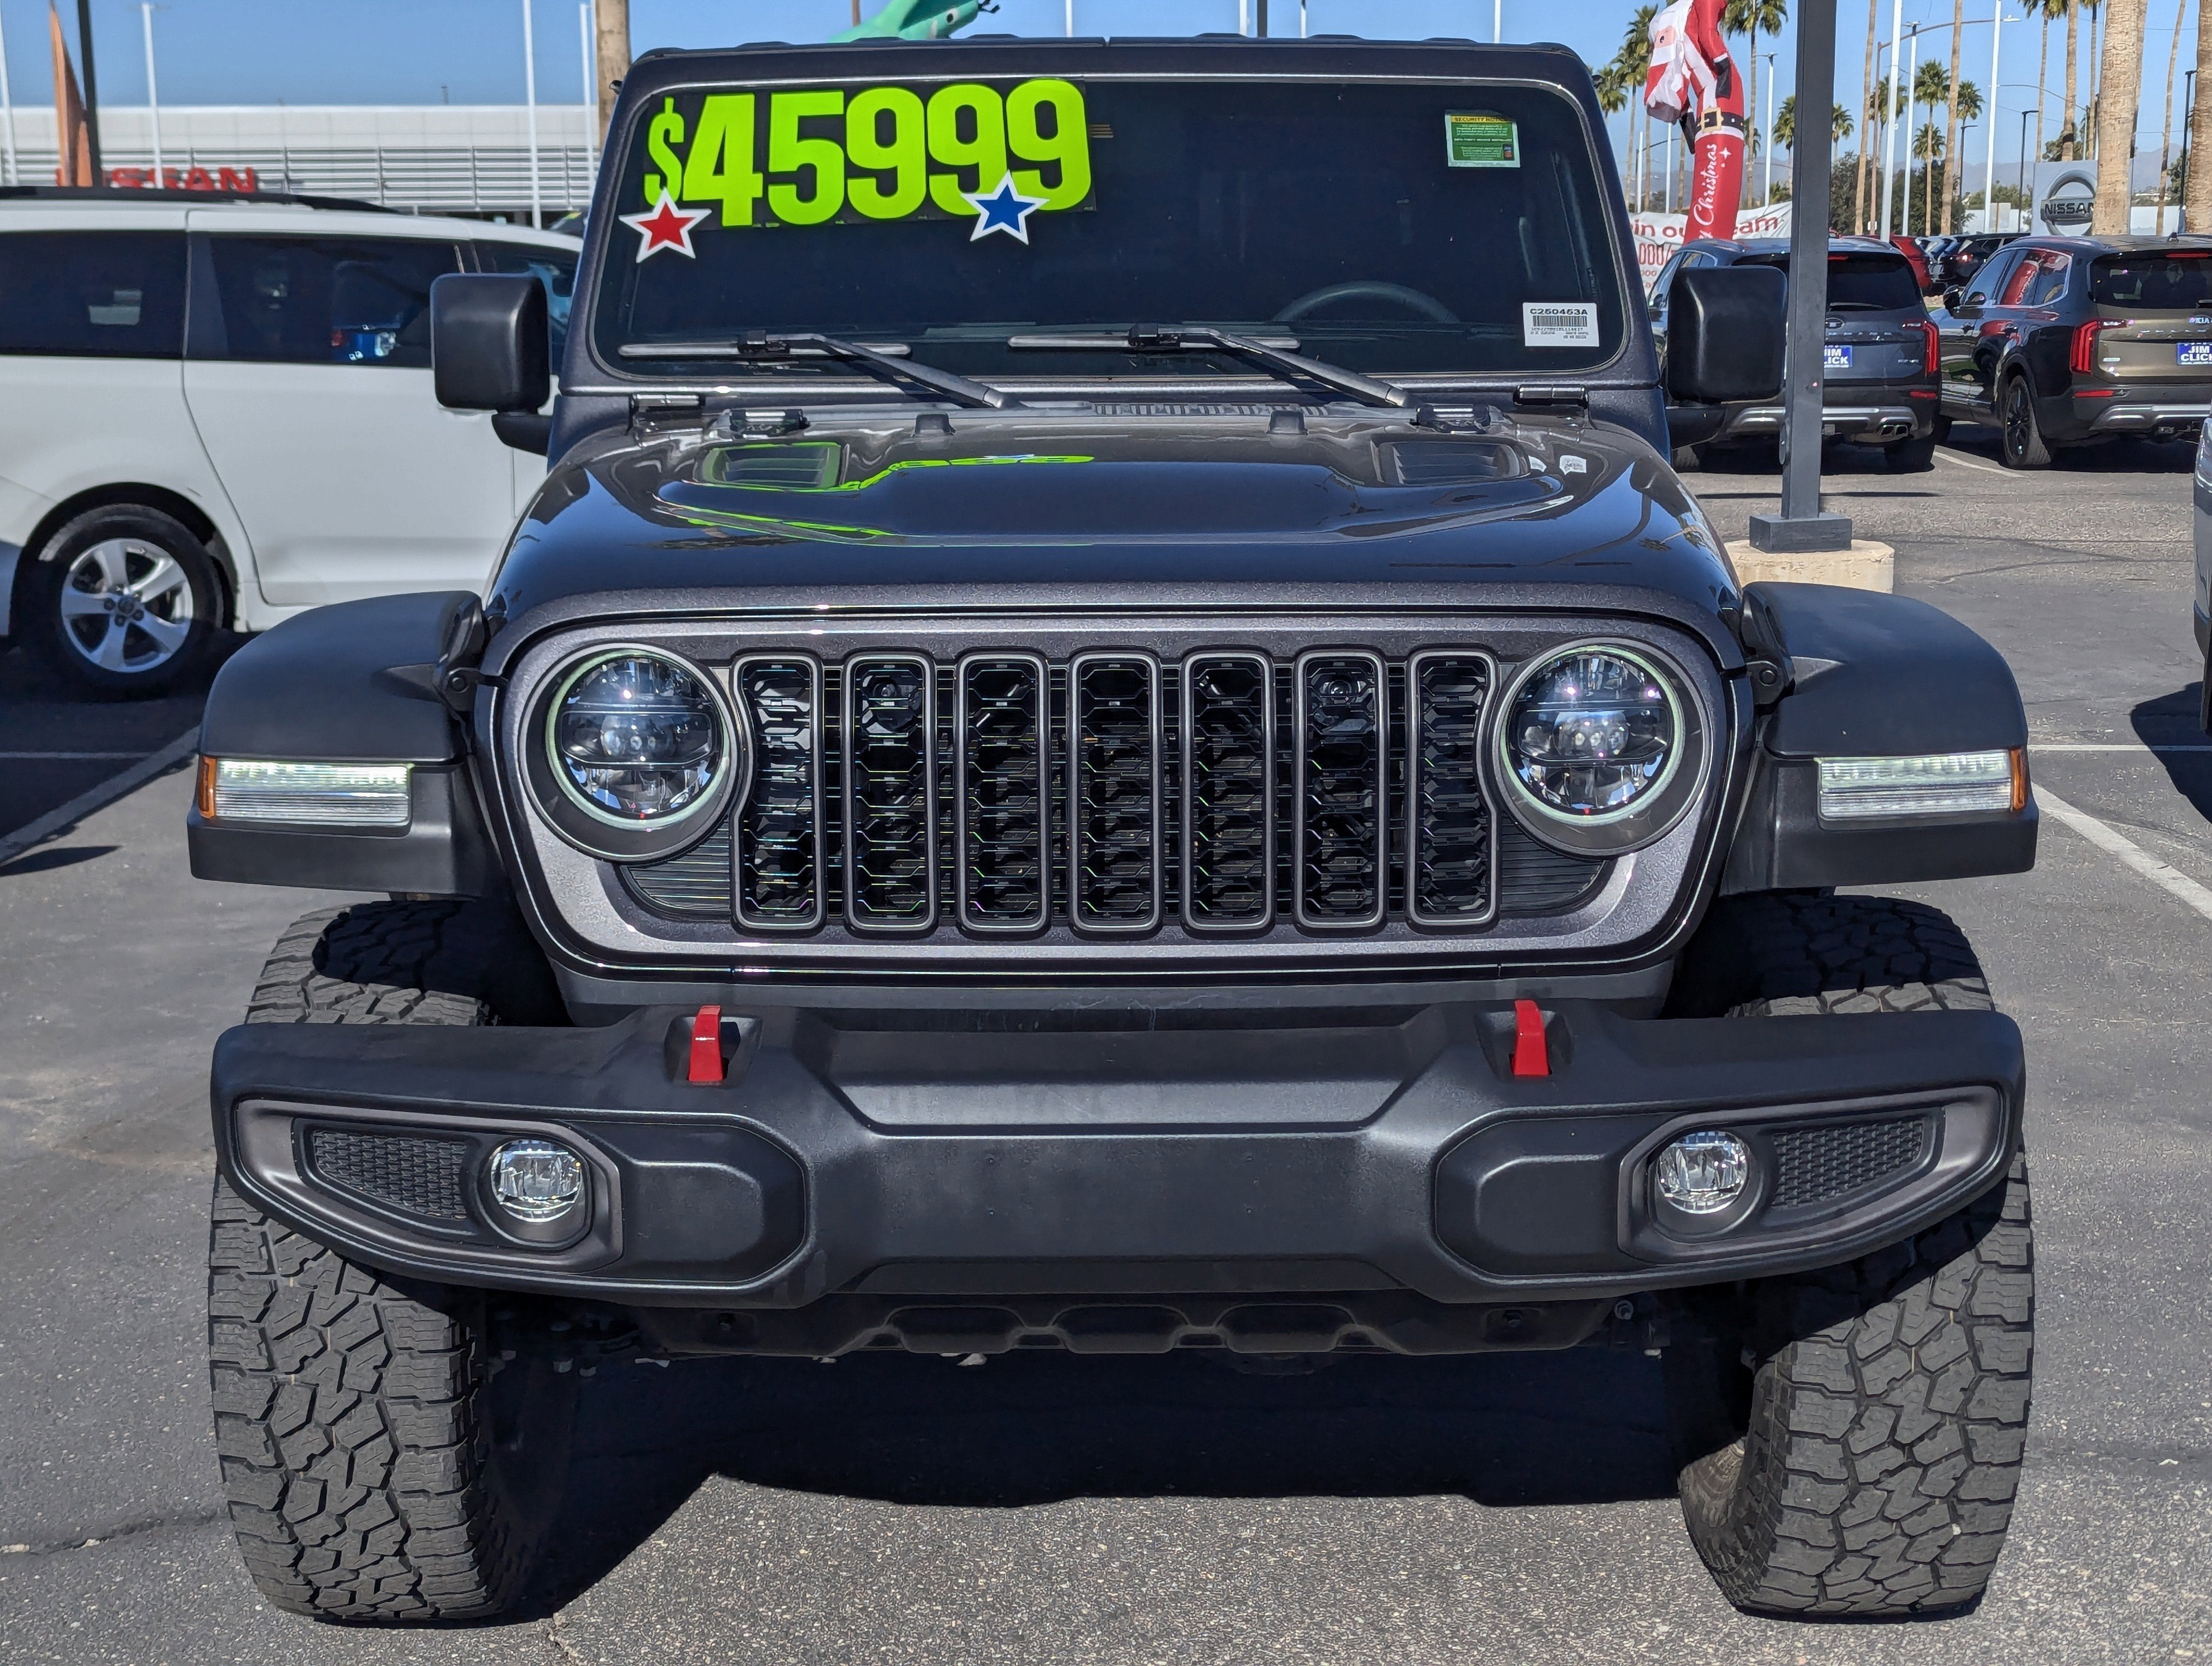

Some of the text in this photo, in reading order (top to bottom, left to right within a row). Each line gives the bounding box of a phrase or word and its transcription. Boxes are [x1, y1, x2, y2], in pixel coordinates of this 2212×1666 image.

[644, 79, 1091, 227] $45999
[56, 167, 256, 193] SSAN
[1693, 144, 1719, 226] Christmas
[1824, 356, 1849, 364] ICK
[2188, 345, 2210, 354] JIM
